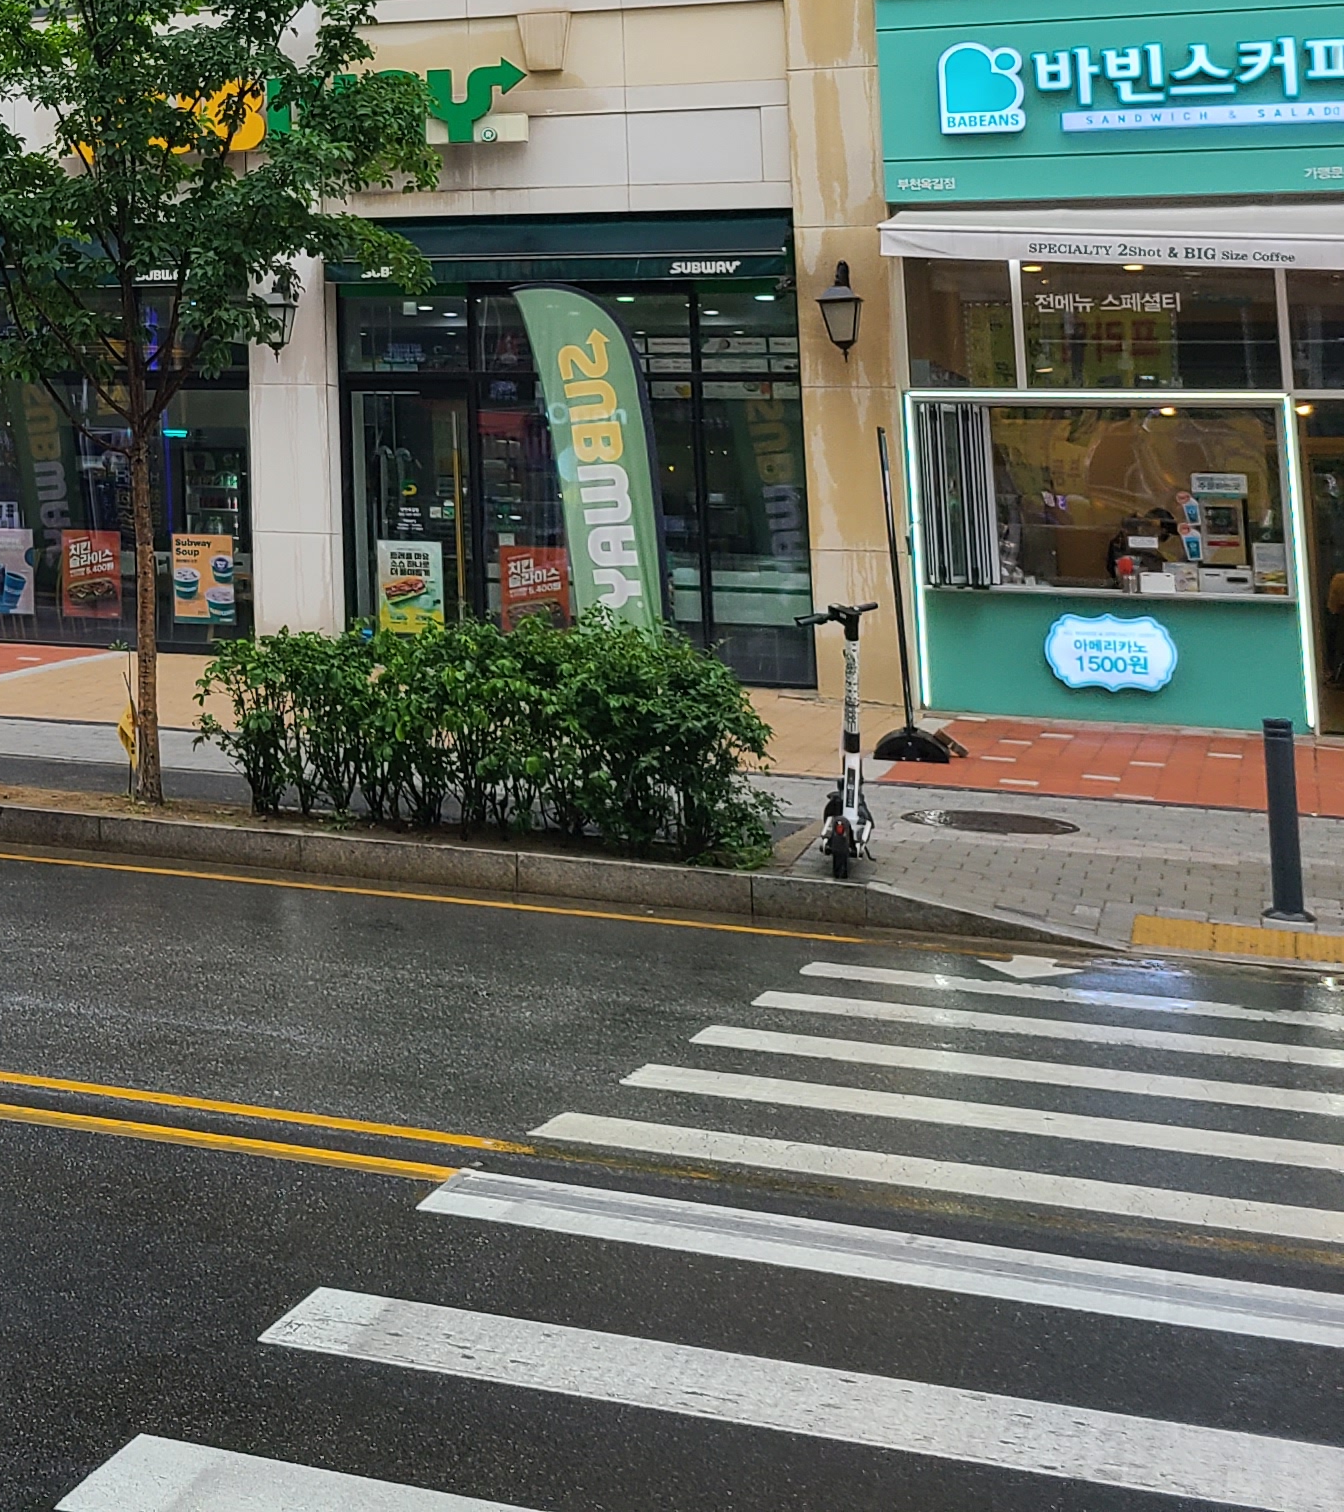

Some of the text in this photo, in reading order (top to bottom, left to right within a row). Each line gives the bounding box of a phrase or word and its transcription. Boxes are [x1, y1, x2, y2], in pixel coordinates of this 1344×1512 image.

[946, 113, 1020, 128] BABEANS
[1085, 110, 1208, 125] SANDWICH
[1028, 242, 1296, 263] SPECIALTY 2Shot & BIG Size Coffee
[669, 260, 741, 275] SUBWAY
[1034, 292, 1182, 313] 전메뉴 스페셜티
[175, 537, 212, 550] Subway
[175, 547, 200, 559] Soup
[1074, 639, 1148, 654] 아메리카노
[1075, 654, 1149, 676] 1500원
